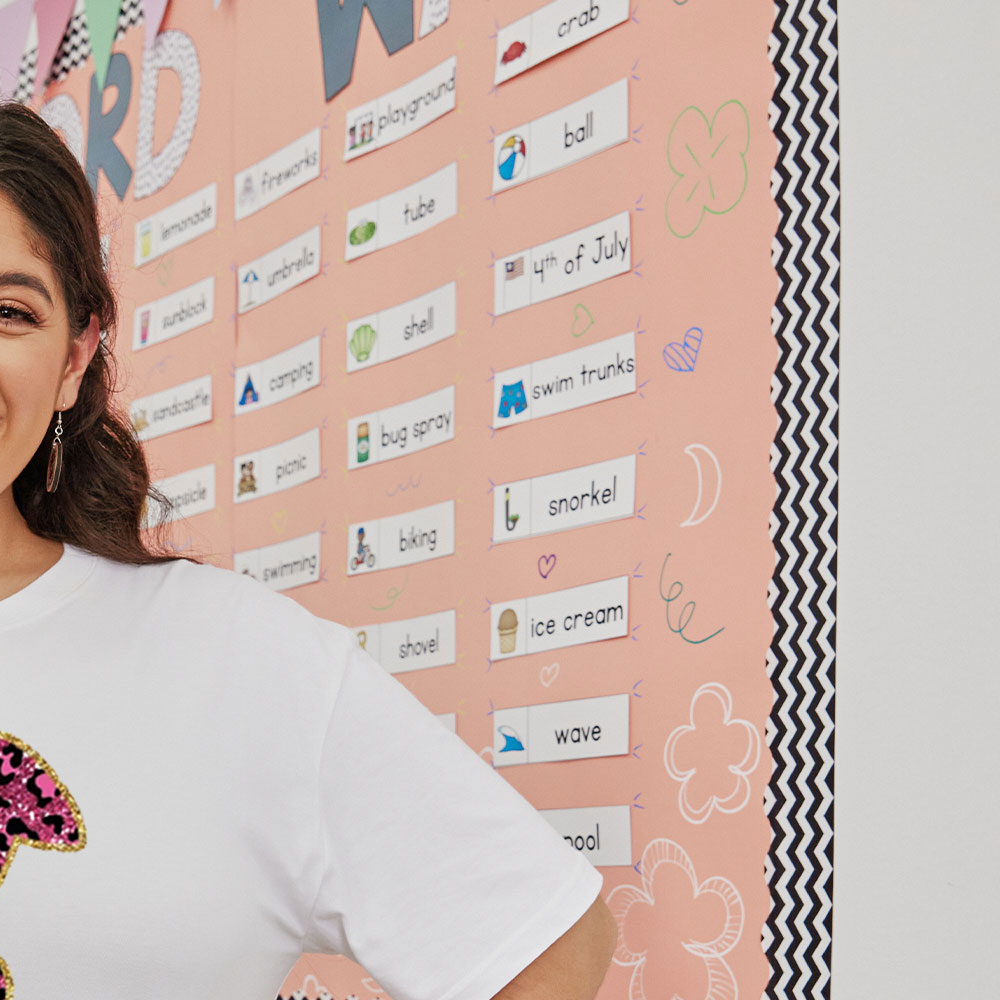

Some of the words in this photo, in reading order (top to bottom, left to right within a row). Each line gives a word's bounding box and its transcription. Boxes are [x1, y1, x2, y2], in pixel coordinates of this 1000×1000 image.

[557, 0, 601, 38] crab
[377, 66, 457, 136] playground
[564, 111, 594, 149] ball
[261, 147, 318, 193] fireworks
[161, 200, 213, 241] lemonade
[403, 195, 436, 225] tube
[267, 246, 315, 288] umbrella
[533, 250, 558, 283] 4th
[564, 243, 586, 275] of
[591, 230, 629, 265] July
[403, 305, 435, 341] shell
[269, 361, 314, 392] camping
[532, 375, 574, 400] swim
[580, 352, 635, 387] trunks
[380, 424, 408, 449] bug
[412, 411, 452, 442] spray
[275, 455, 308, 484] picnic
[548, 475, 617, 516] snorkel
[399, 526, 437, 552] biking
[263, 554, 317, 583] swimming
[531, 618, 556, 638] ice
[563, 604, 624, 632] cream
[399, 627, 440, 659] shovel
[554, 725, 602, 745] wave
